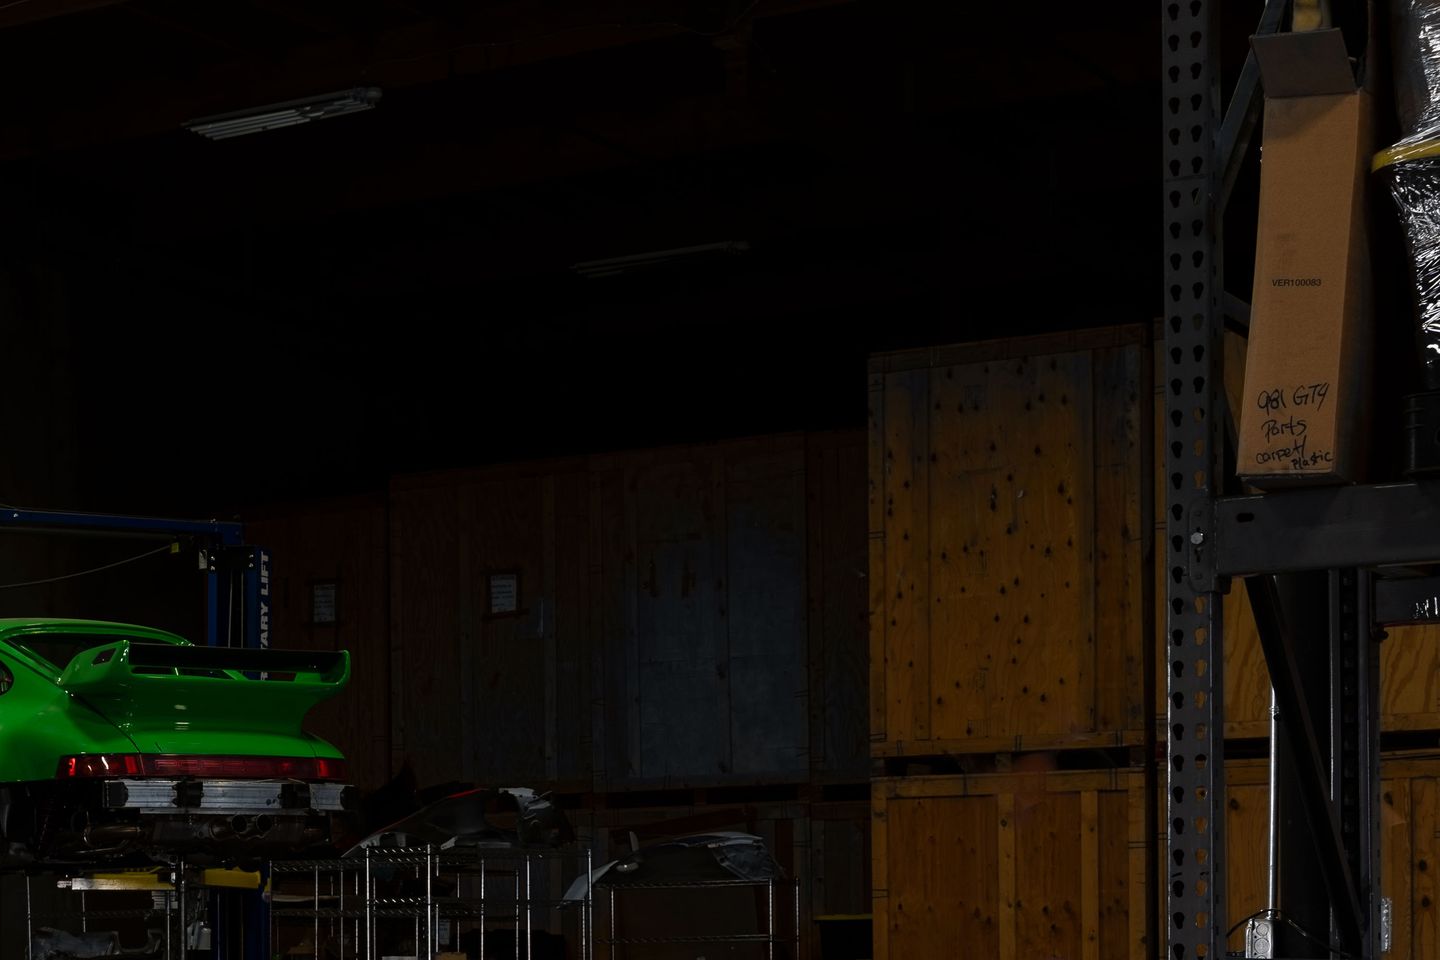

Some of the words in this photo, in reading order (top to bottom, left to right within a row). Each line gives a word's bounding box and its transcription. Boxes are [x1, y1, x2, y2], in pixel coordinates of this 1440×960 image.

[1257, 389, 1287, 416] 981
[1293, 382, 1330, 411] GT4
[260, 551, 269, 596] LIFT
